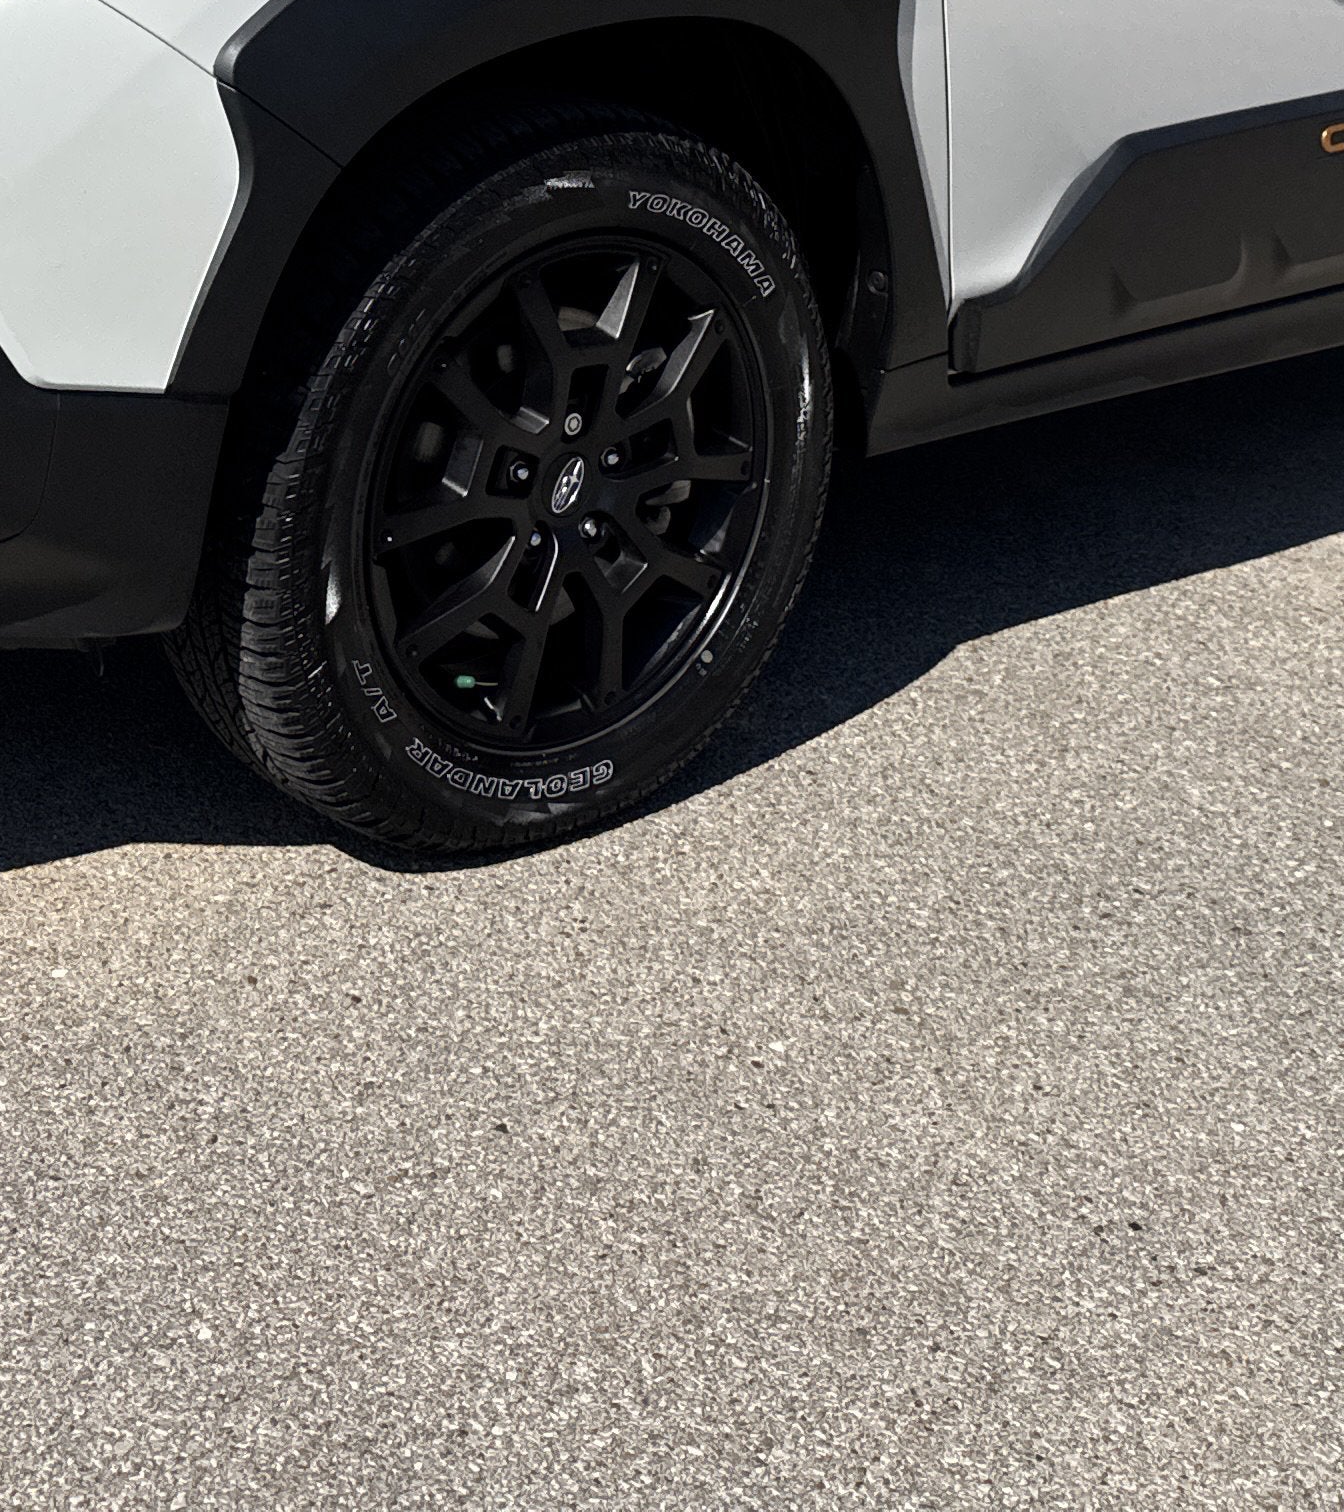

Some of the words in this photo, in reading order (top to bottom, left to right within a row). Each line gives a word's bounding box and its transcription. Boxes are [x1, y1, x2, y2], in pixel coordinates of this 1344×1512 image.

[628, 190, 776, 297] YOKOHAMA
[352, 659, 398, 723] A/T
[406, 738, 614, 800] GEOLANDAR
